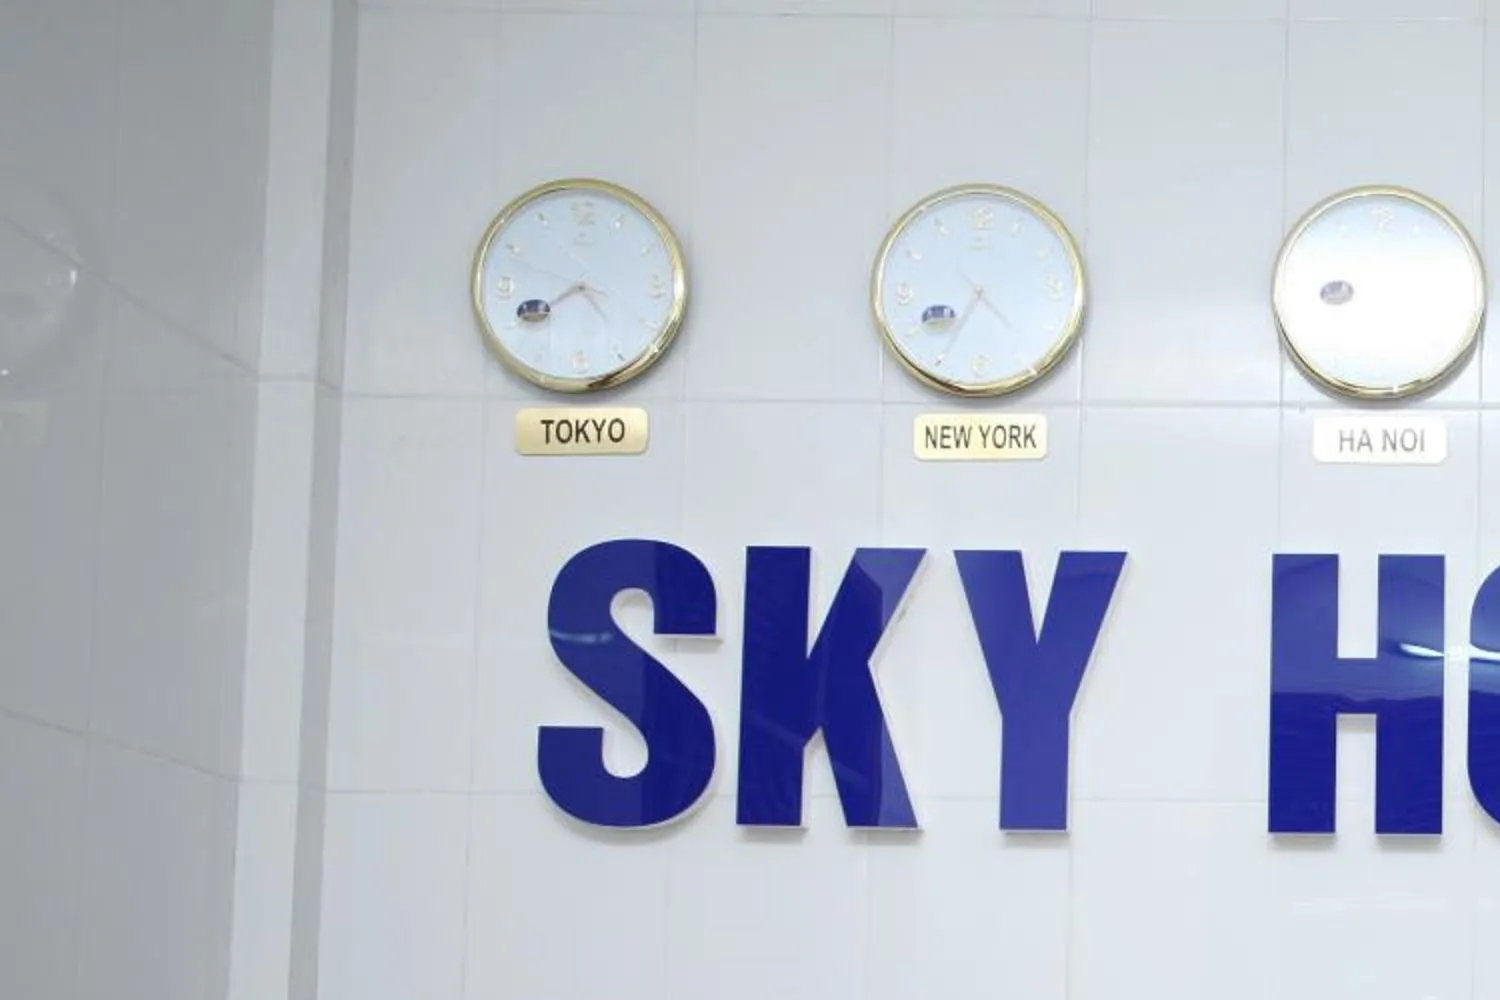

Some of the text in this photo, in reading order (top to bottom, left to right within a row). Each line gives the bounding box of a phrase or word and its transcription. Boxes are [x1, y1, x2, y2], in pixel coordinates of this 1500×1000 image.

[540, 418, 625, 445] TOKYO
[924, 424, 1037, 450] NEW YORK
[1339, 428, 1427, 453] HA NOI
[538, 538, 1128, 830] SKY
